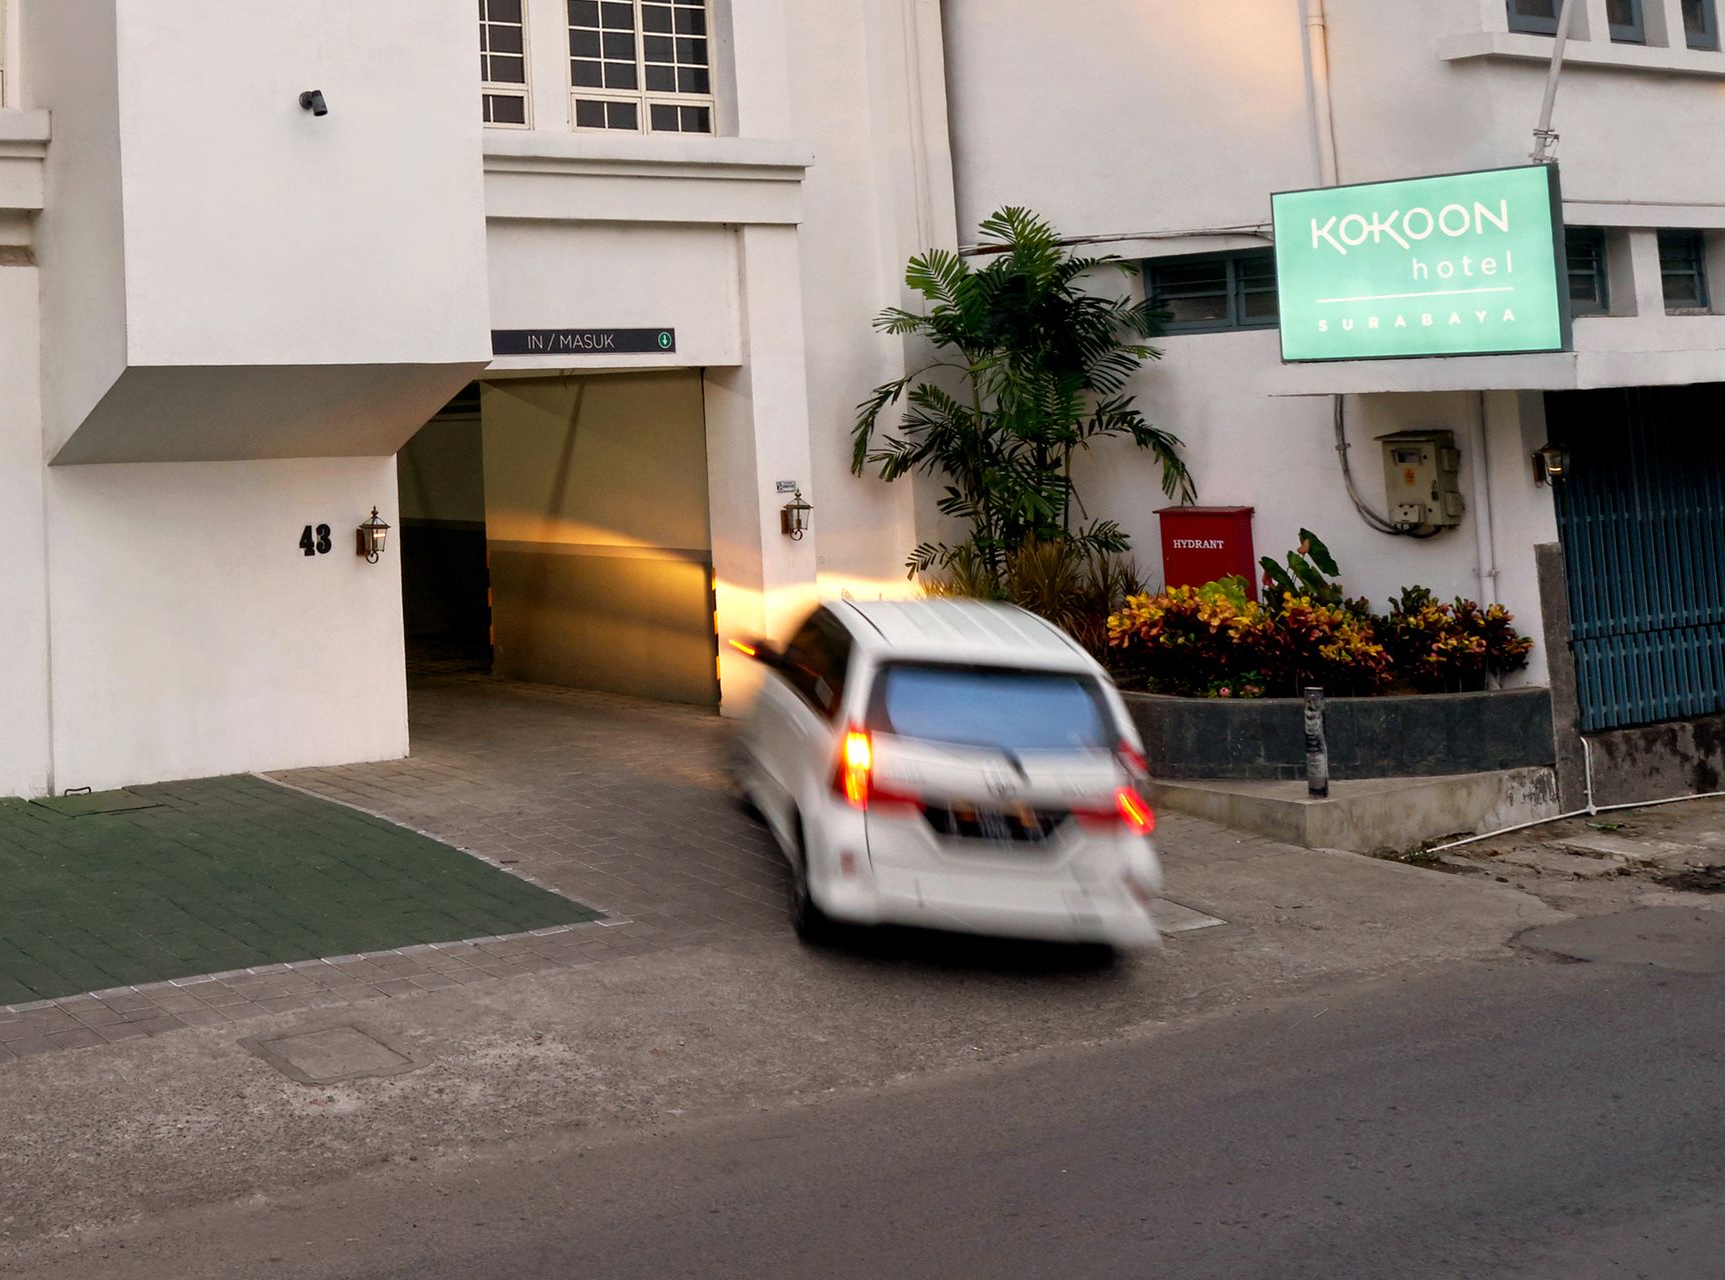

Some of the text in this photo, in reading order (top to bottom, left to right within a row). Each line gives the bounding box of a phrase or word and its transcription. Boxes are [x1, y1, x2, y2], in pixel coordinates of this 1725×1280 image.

[1310, 199, 1509, 255] KOKOON
[1412, 250, 1513, 280] hotel
[1318, 308, 1516, 332] SURABAYA
[528, 335, 543, 349] IN
[560, 334, 615, 349] MASUK
[299, 523, 332, 556] 43
[1173, 539, 1224, 549] HYDRANT
